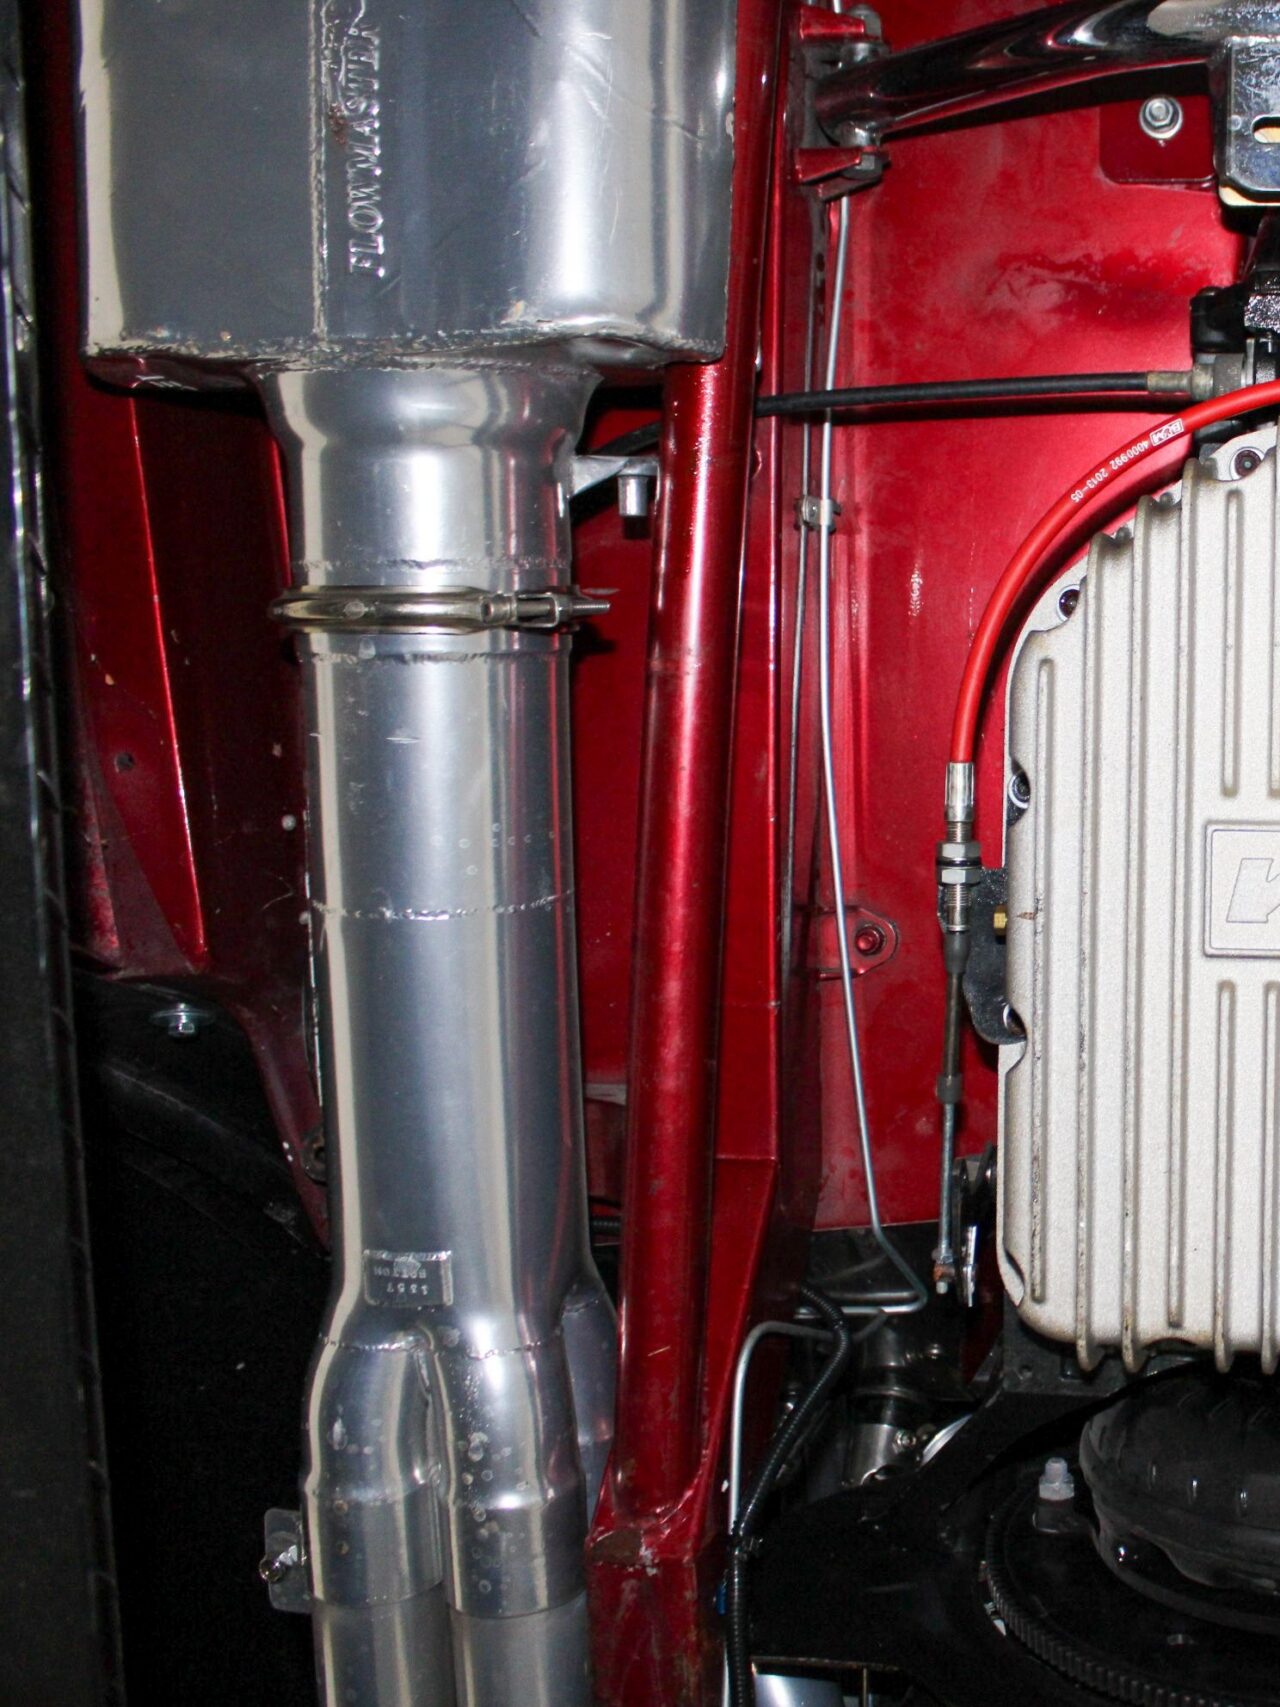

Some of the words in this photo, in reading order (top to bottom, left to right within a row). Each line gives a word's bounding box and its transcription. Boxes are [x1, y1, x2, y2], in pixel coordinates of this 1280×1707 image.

[346, 24, 386, 279] FLOWMASTER
[1109, 440, 1149, 470] 4000992
[1071, 468, 1109, 503] 2013-05
